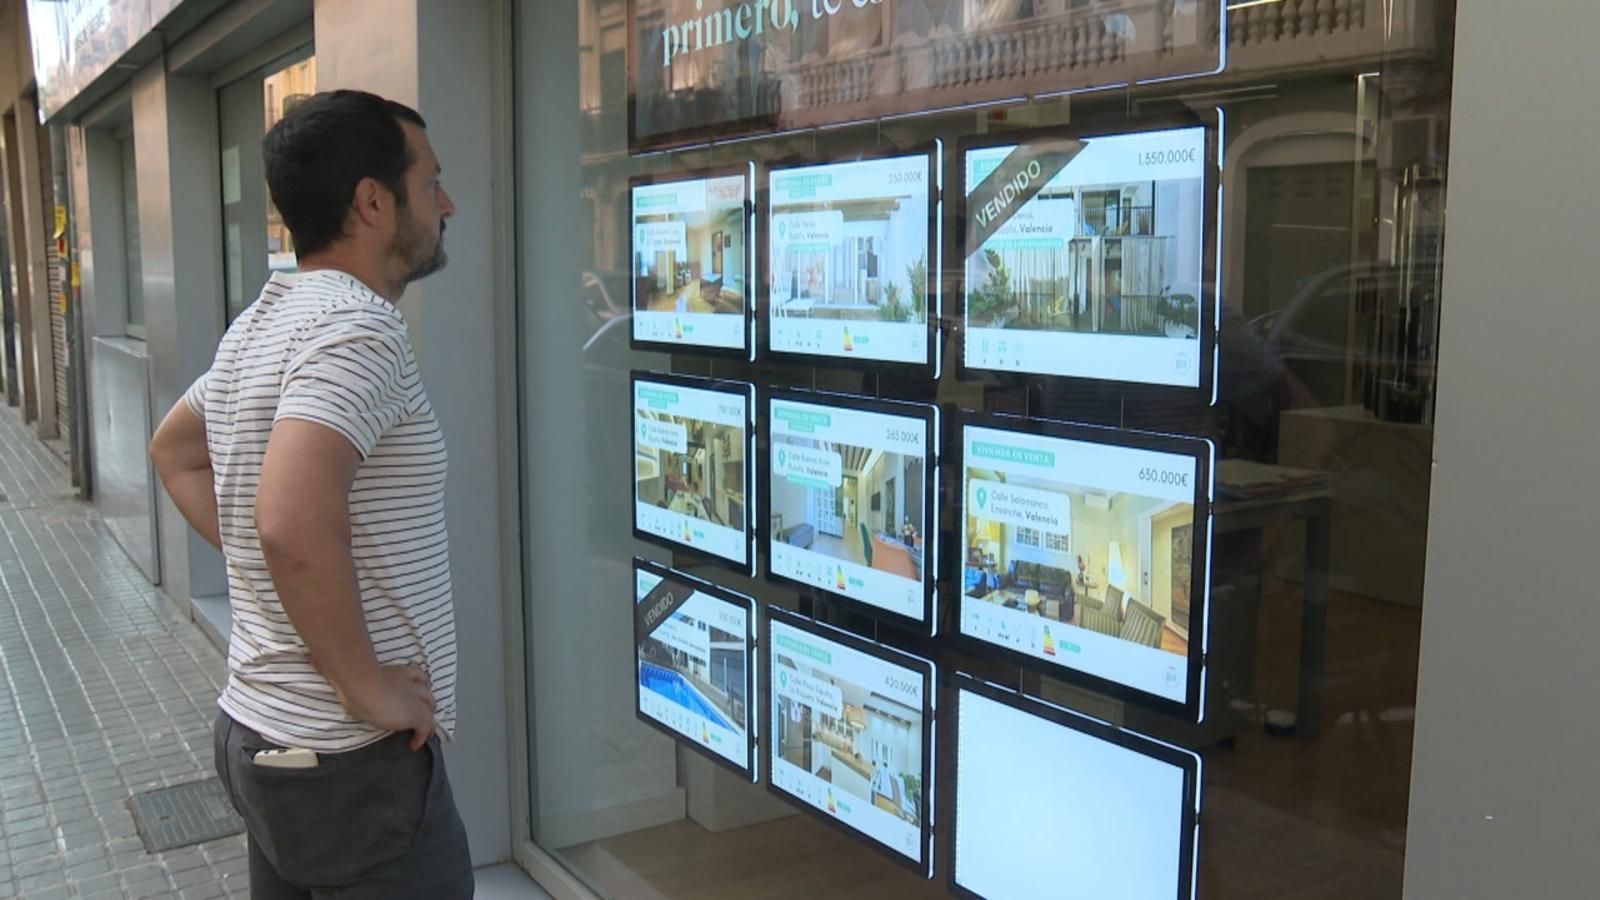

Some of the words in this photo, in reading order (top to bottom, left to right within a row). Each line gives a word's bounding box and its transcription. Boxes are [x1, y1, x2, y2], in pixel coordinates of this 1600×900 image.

[975, 159, 1041, 228] VENDIDO
[1019, 222, 1053, 233] Valencia
[976, 444, 1011, 458] VIVIENDA
[1012, 449, 1022, 460] EN
[1023, 451, 1050, 465] VENTA
[991, 489, 1008, 501] Calle
[1025, 511, 1058, 526] Valencia
[643, 592, 674, 627] VENDIDO
